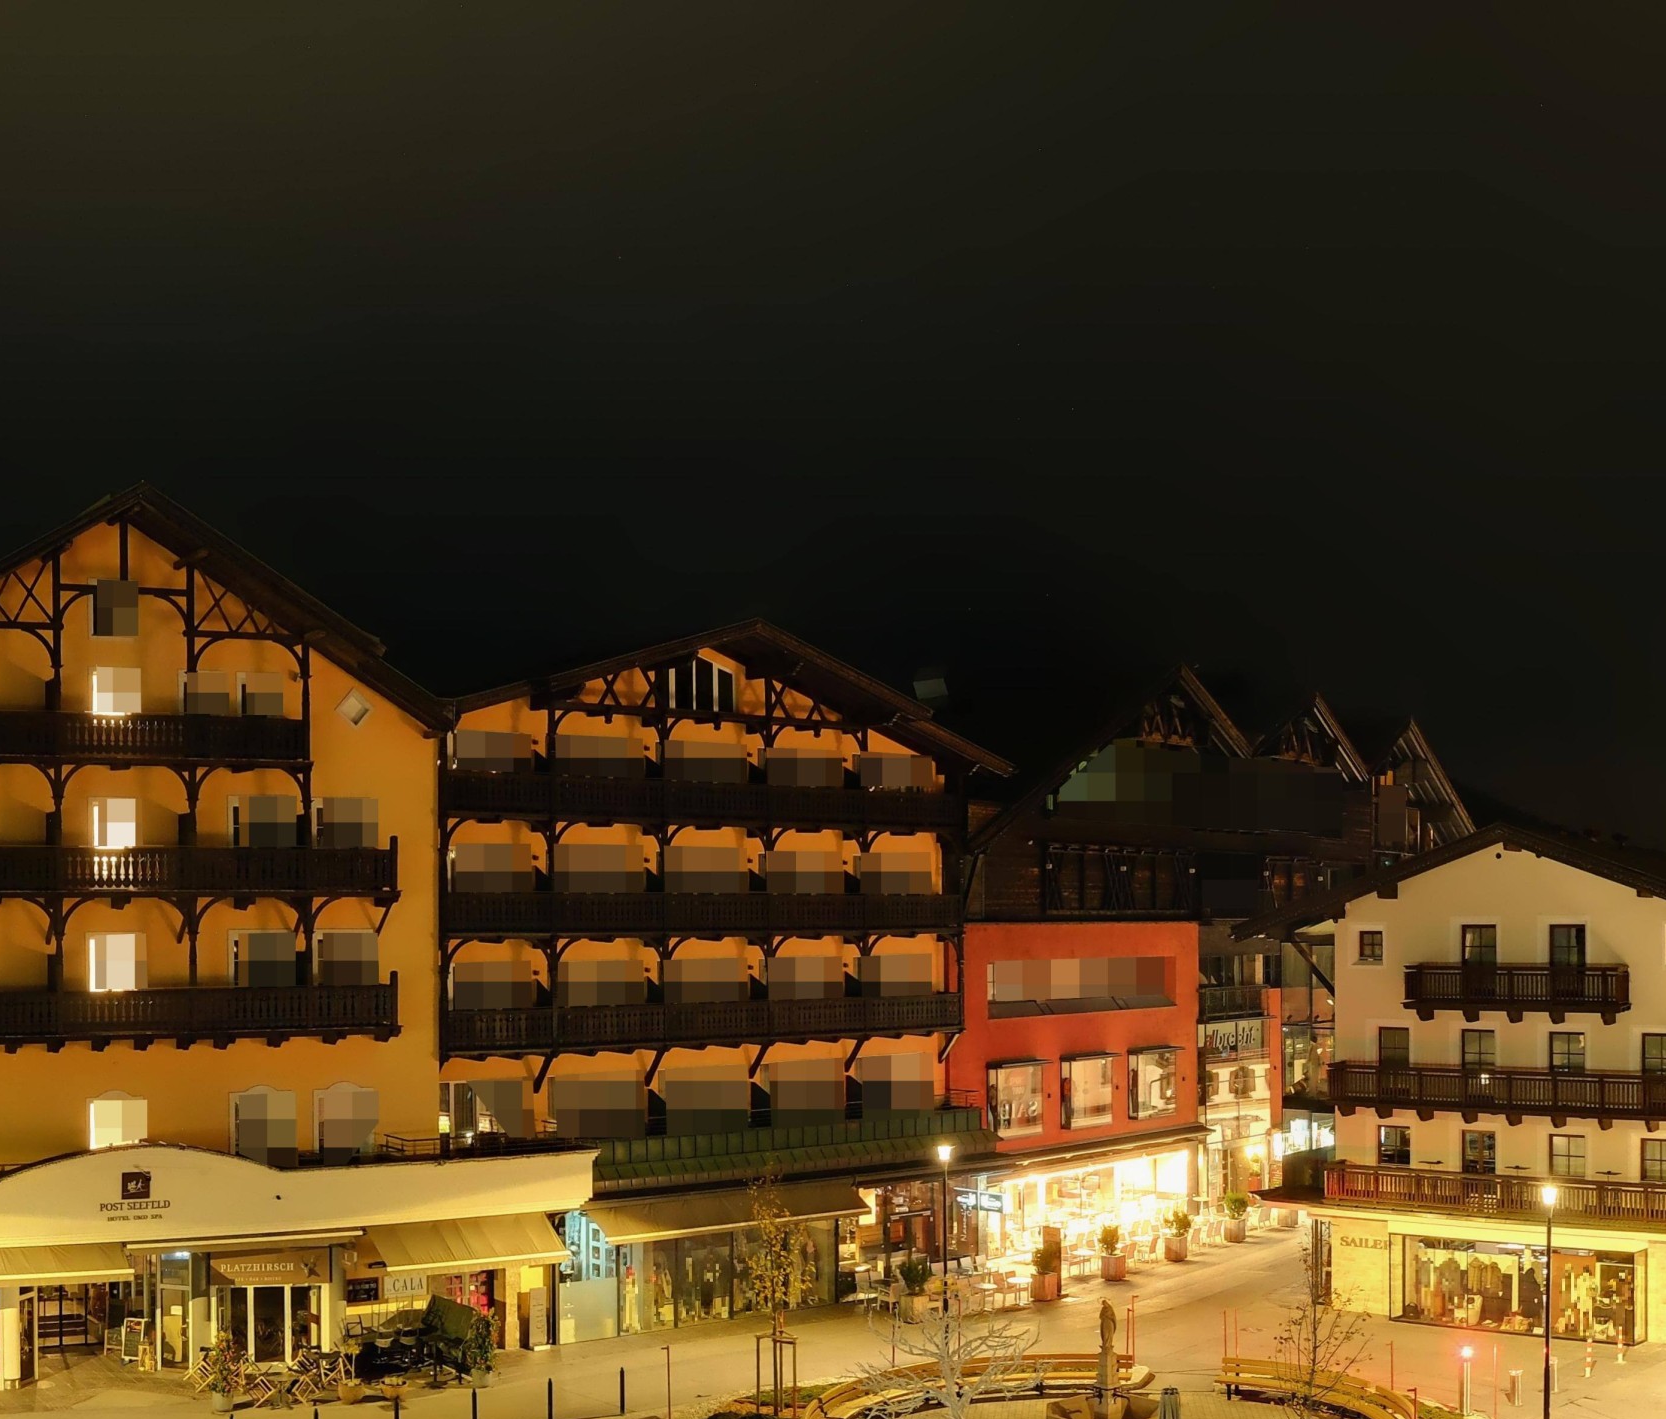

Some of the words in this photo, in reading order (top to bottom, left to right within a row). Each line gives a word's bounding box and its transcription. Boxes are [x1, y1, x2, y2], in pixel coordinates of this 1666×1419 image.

[99, 1202, 125, 1212] POST
[127, 1200, 171, 1211] SEEFELD
[220, 1262, 294, 1272] PLATZHIRSCH
[392, 1275, 424, 1292] CALA
